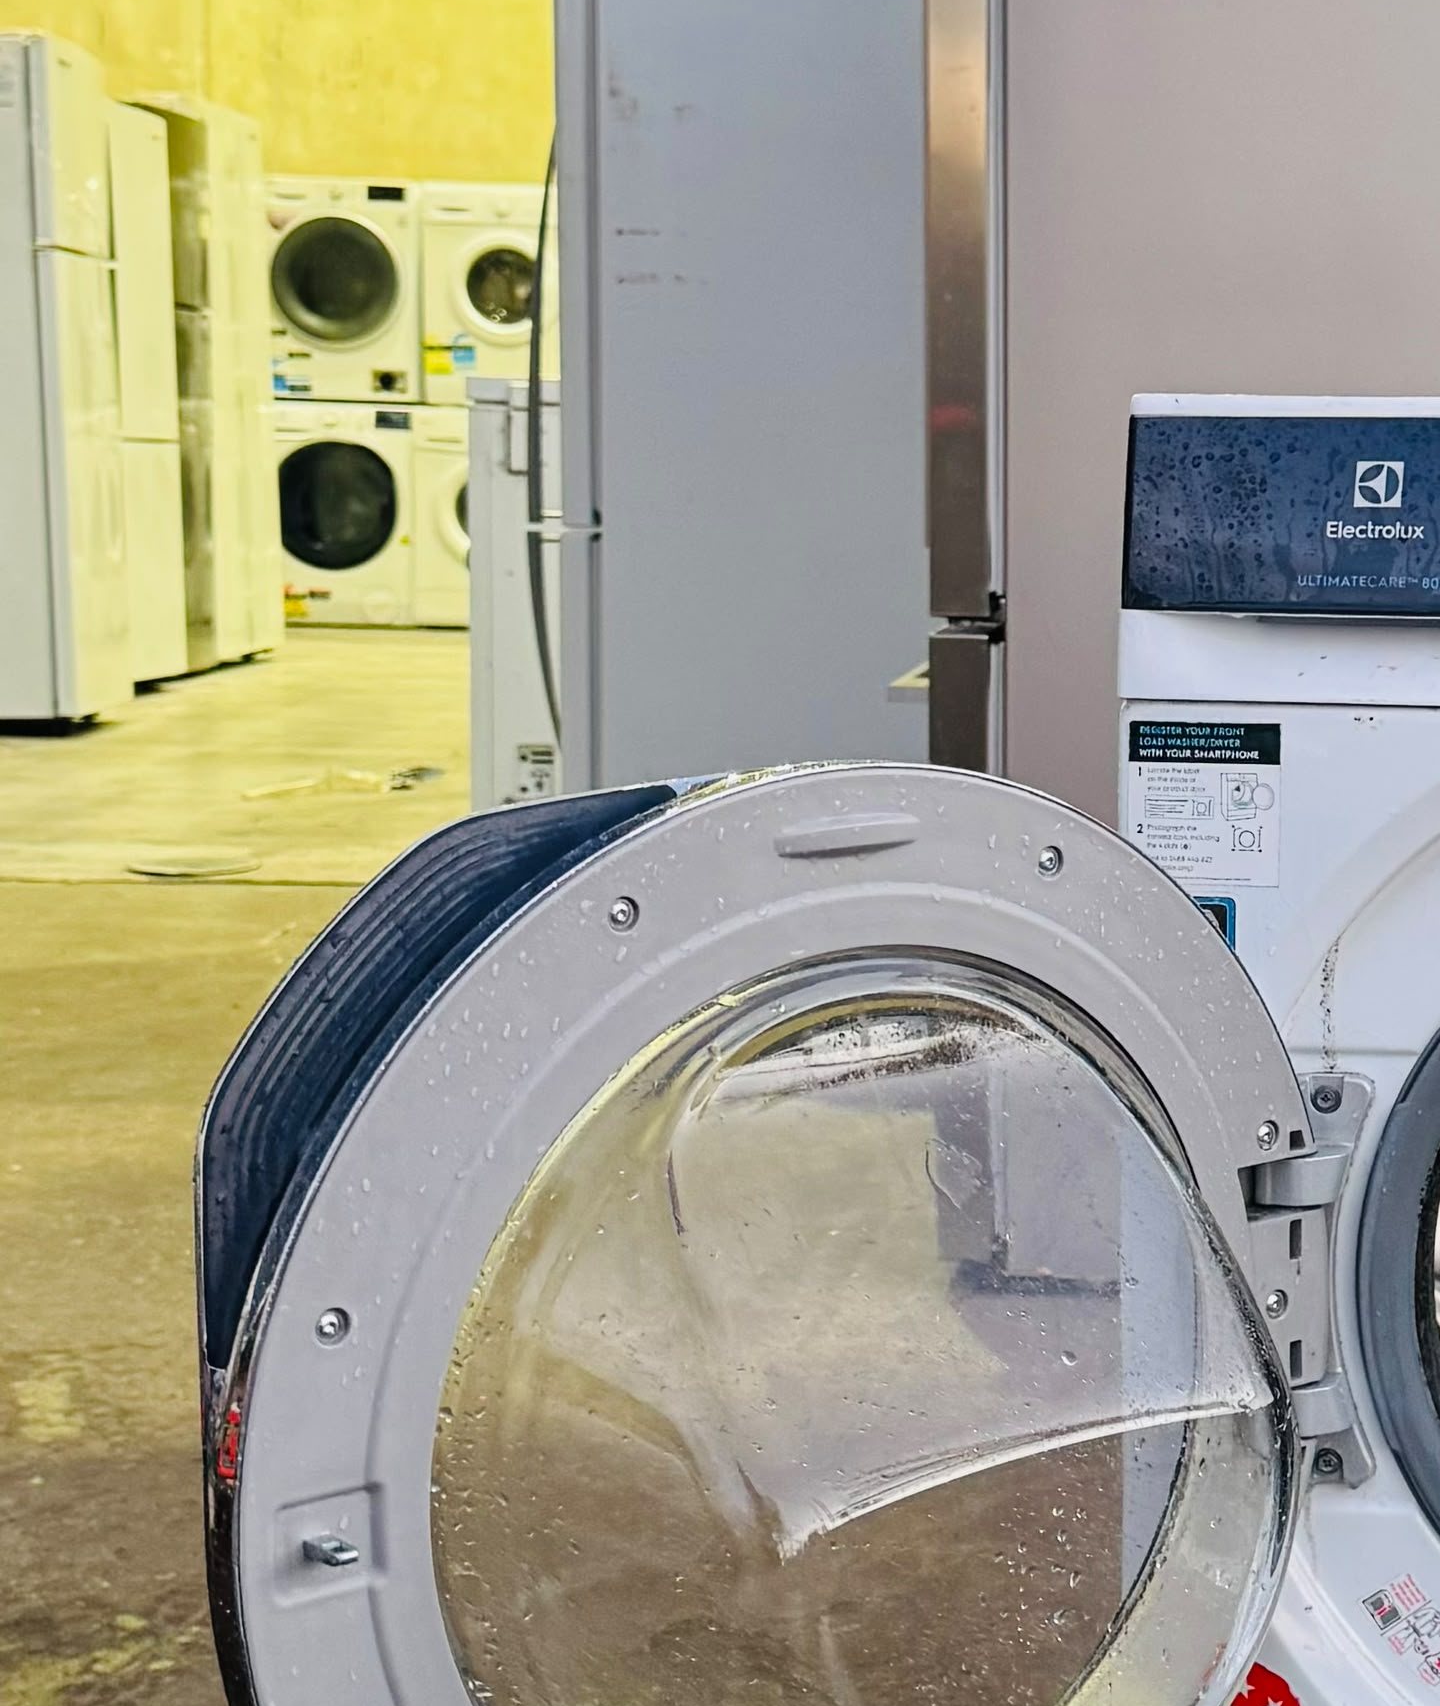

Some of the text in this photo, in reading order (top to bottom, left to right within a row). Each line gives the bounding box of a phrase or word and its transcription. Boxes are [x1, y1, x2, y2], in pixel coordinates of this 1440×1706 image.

[1326, 521, 1425, 539] Electrolux
[1139, 726, 1245, 736] REGISTER YOUR FRONT
[1139, 737, 1241, 748] LOAD WASHER/DRYER
[1139, 748, 1260, 759] WITH YOUR SMARTPHONE
[1138, 766, 1142, 776] 1
[1137, 823, 1143, 833] 2
